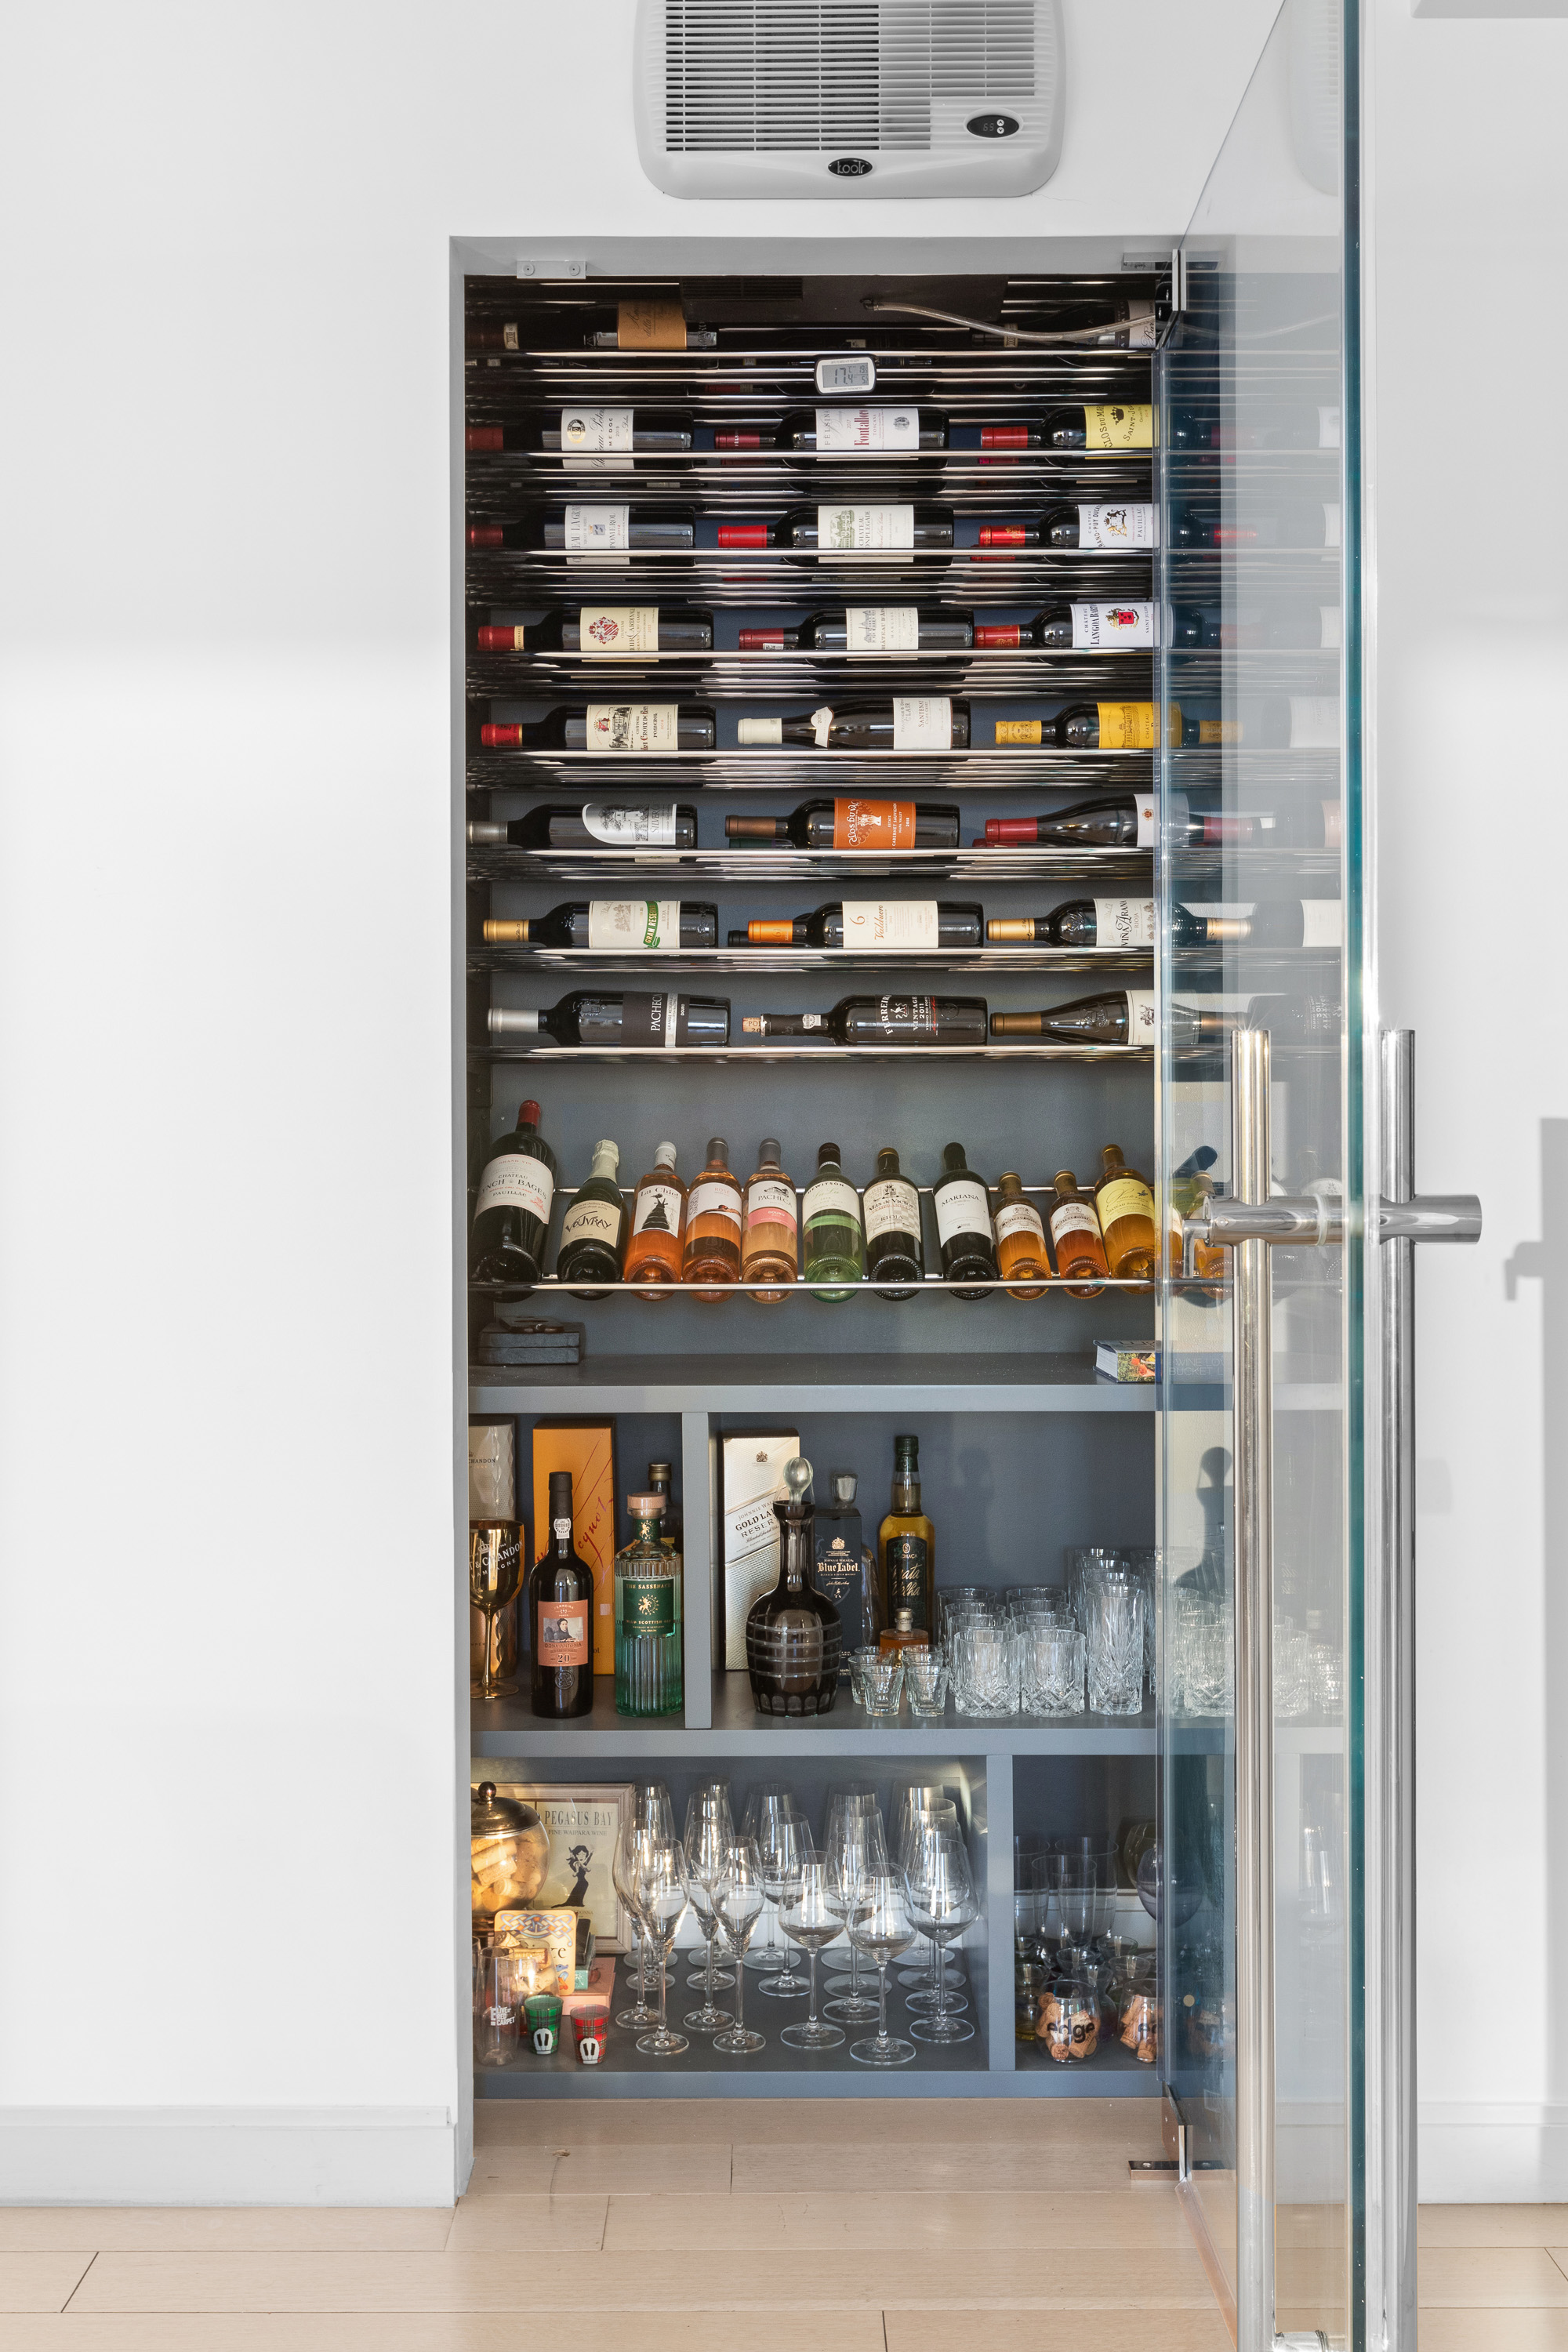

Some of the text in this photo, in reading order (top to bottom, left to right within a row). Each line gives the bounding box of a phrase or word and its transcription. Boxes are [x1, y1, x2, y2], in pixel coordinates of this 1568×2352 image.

[1090, 618, 1100, 644] LANGOA
[640, 721, 648, 740] CROIX
[650, 811, 659, 833] SILVER
[644, 905, 657, 944] GRAN RESERVA
[849, 916, 866, 925] 6
[874, 905, 885, 941] Valduero
[1116, 900, 1133, 946] VIÑA ARANA
[650, 993, 662, 1032] PACHECA
[517, 1179, 547, 1200] BAGES
[808, 1181, 844, 1194] HEWITSON
[758, 1194, 793, 1208] PACHECA
[869, 1203, 882, 1211] Mas
[941, 1194, 980, 1207] MARIANA
[565, 1210, 612, 1232] VOUVRAY
[1175, 1358, 1202, 1367] WINE
[1168, 1367, 1213, 1376] BUCKET
[739, 1505, 760, 1521] JOHNNIE
[735, 1516, 760, 1531] GOLD
[481, 1539, 523, 1566] CANDON
[817, 1562, 837, 1573] Blue
[557, 1653, 570, 1663] 20
[544, 1809, 614, 1827] PEGASUS BAY
[564, 1828, 591, 1837] WAIPARA
[496, 2014, 507, 2023] RED
[496, 2016, 516, 2027] CARPET
[1047, 2018, 1095, 2045] edge
